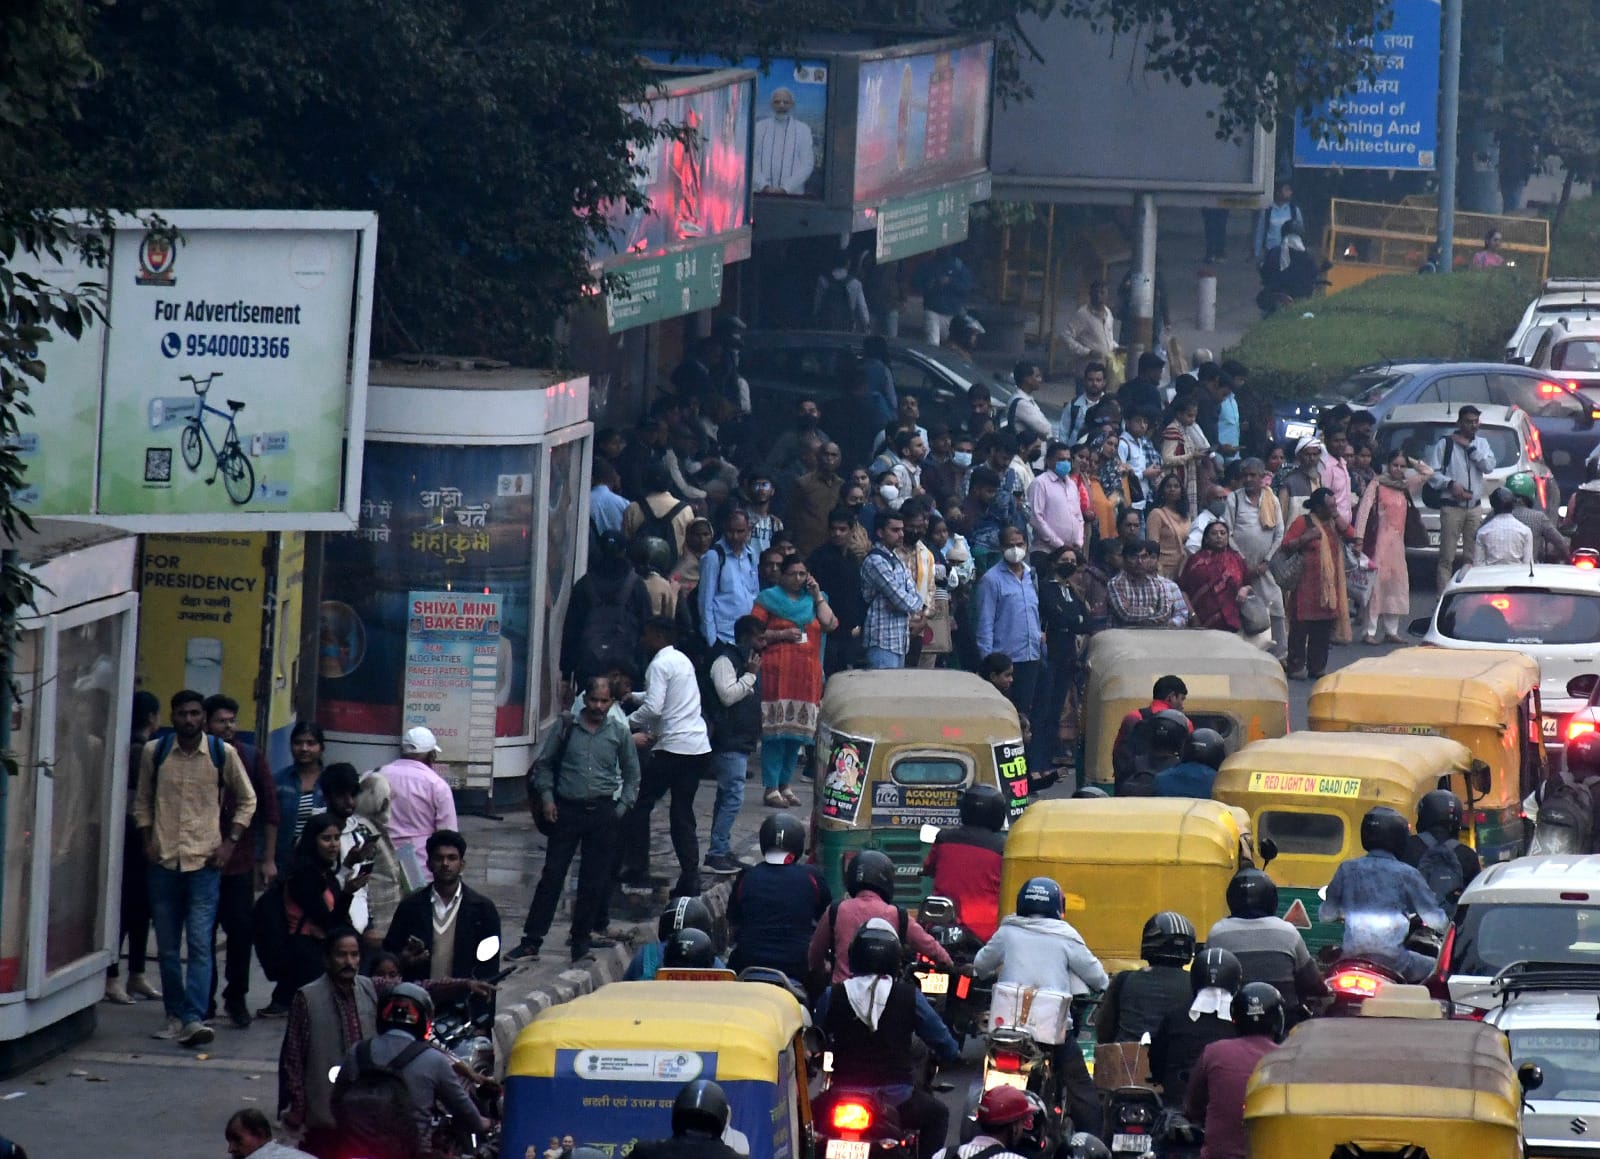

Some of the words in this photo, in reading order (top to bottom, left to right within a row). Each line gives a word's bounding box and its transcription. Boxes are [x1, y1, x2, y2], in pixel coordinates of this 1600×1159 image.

[1383, 34, 1414, 49] तथा
[1328, 101, 1384, 115] School
[1388, 101, 1407, 116] of
[1387, 120, 1421, 135] And
[1316, 137, 1416, 153] Architecture
[154, 300, 181, 321] For
[184, 300, 302, 325] Advertisement
[186, 334, 290, 358] 9540003366
[145, 554, 180, 569] FOR
[145, 572, 257, 592] PRESIDENCY
[413, 600, 458, 615] SHIVA
[462, 602, 497, 616] MINI
[423, 615, 485, 631] BAKERY
[474, 646, 497, 654] RATE
[431, 655, 462, 663] PATTIES
[406, 703, 421, 711] HOT
[1264, 775, 1280, 790] RED
[1280, 776, 1304, 792] LIGHT
[1304, 777, 1317, 793] ON
[1319, 778, 1343, 794] GAADI
[1343, 780, 1359, 795] OFF
[905, 790, 958, 800] ACCOUNTS
[905, 798, 958, 807] MANAGER
